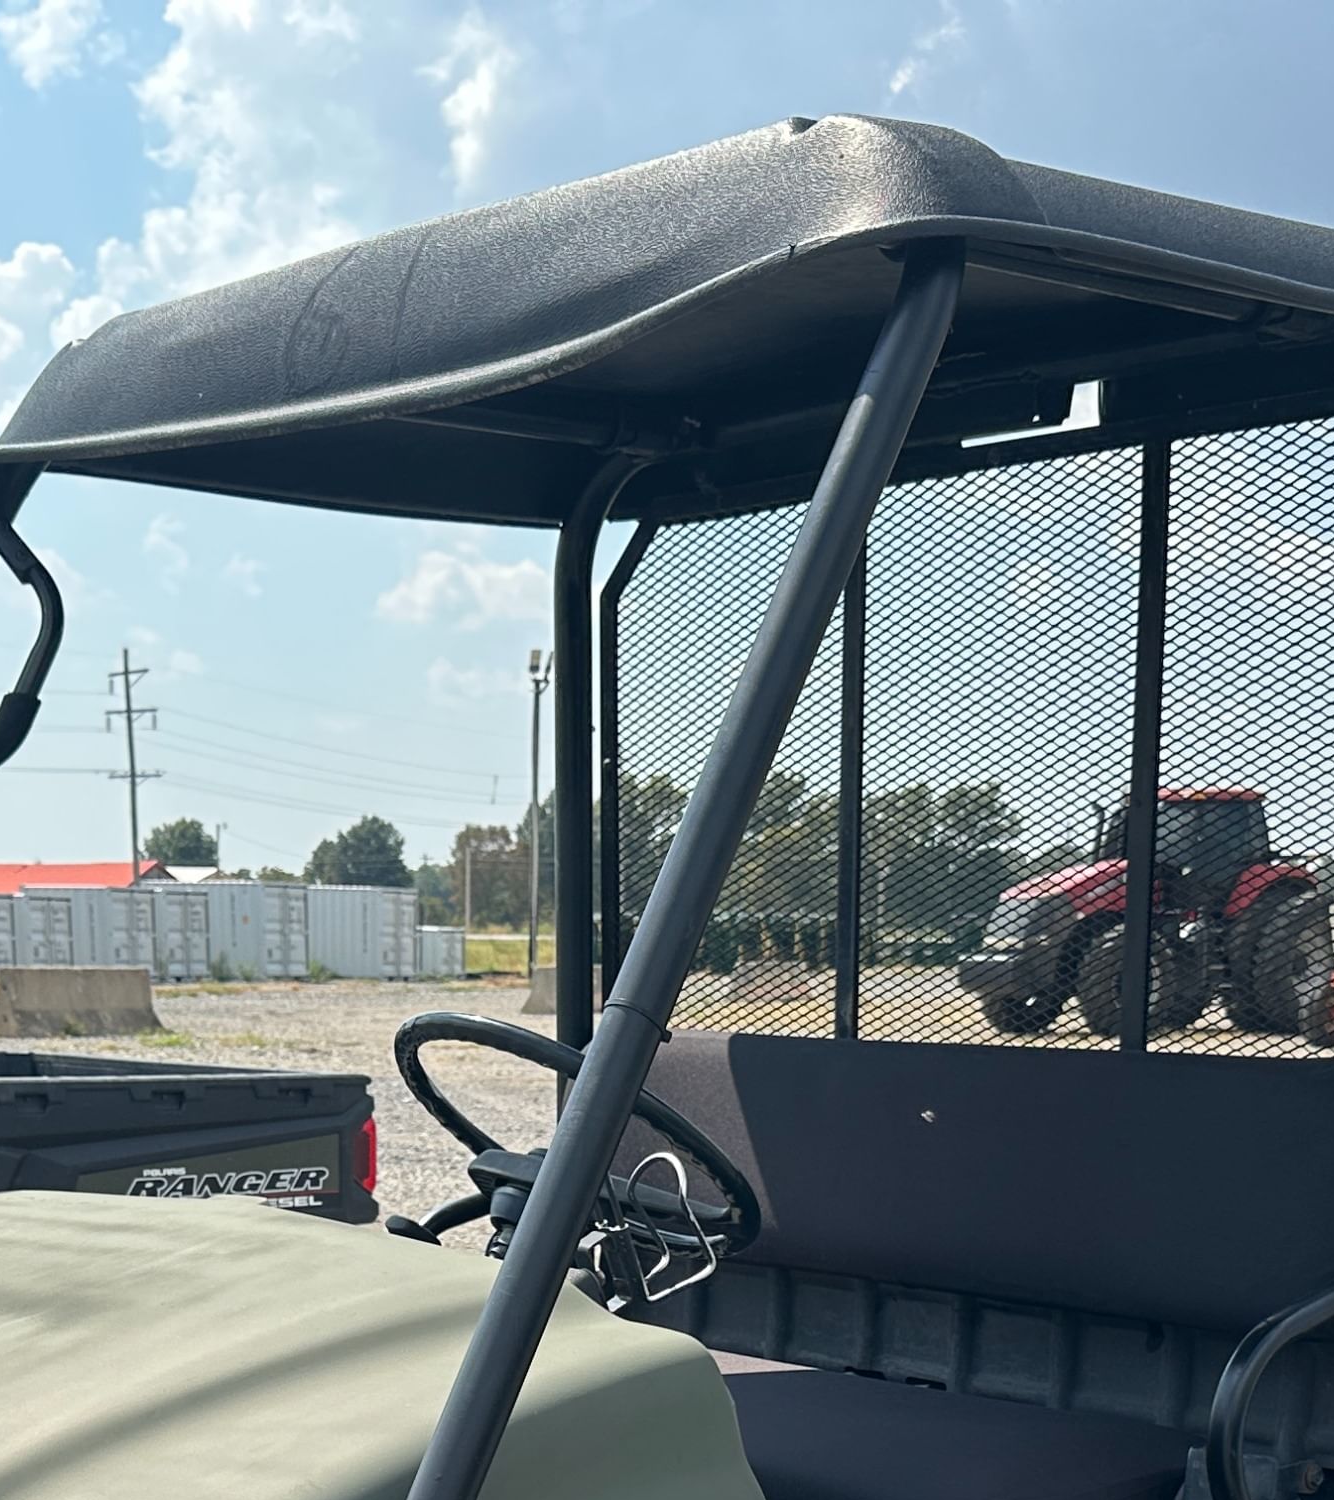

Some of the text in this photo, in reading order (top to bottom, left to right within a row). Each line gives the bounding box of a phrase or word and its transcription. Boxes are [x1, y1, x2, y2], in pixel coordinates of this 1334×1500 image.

[142, 1166, 186, 1177] POLARIS
[127, 1166, 330, 1199] RANGER
[266, 1194, 324, 1209] ESEL
